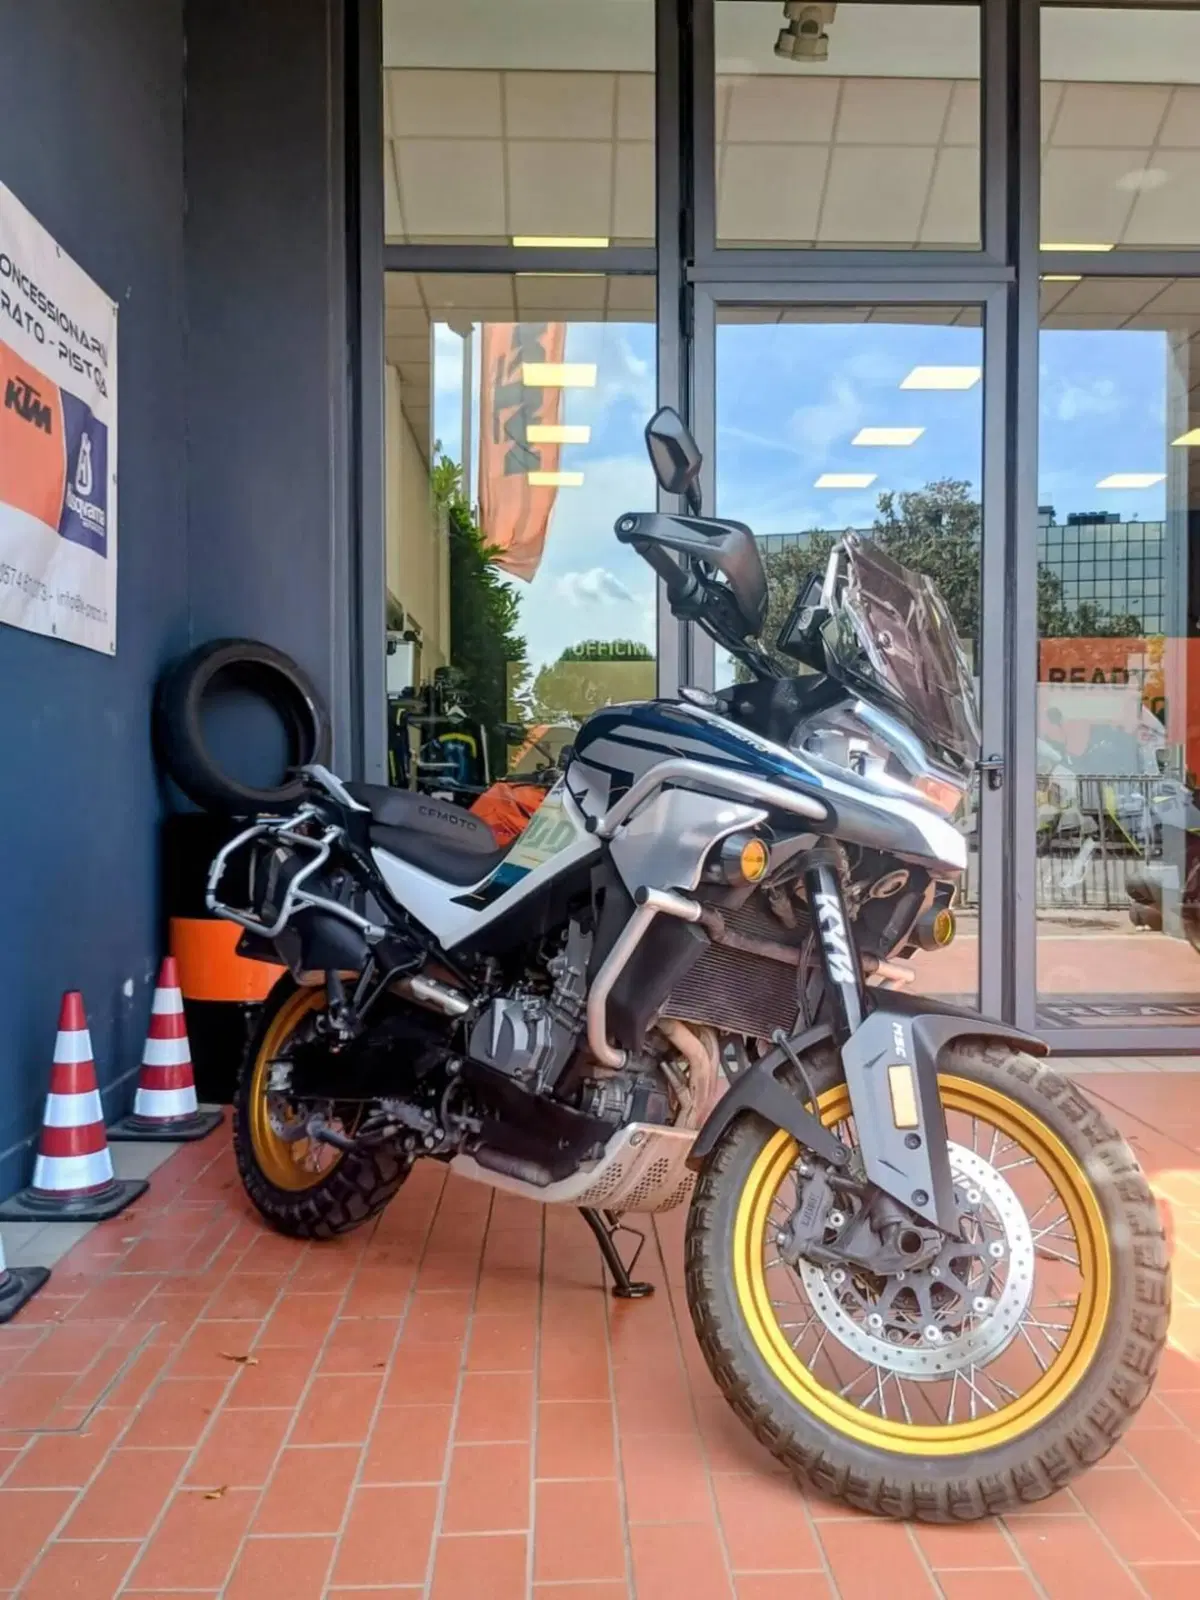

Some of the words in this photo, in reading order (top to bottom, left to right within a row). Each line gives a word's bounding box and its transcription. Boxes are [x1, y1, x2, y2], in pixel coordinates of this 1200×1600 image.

[4, 375, 52, 435] KTM
[1049, 667, 1141, 690] READ
[418, 804, 478, 832] CFMOTO
